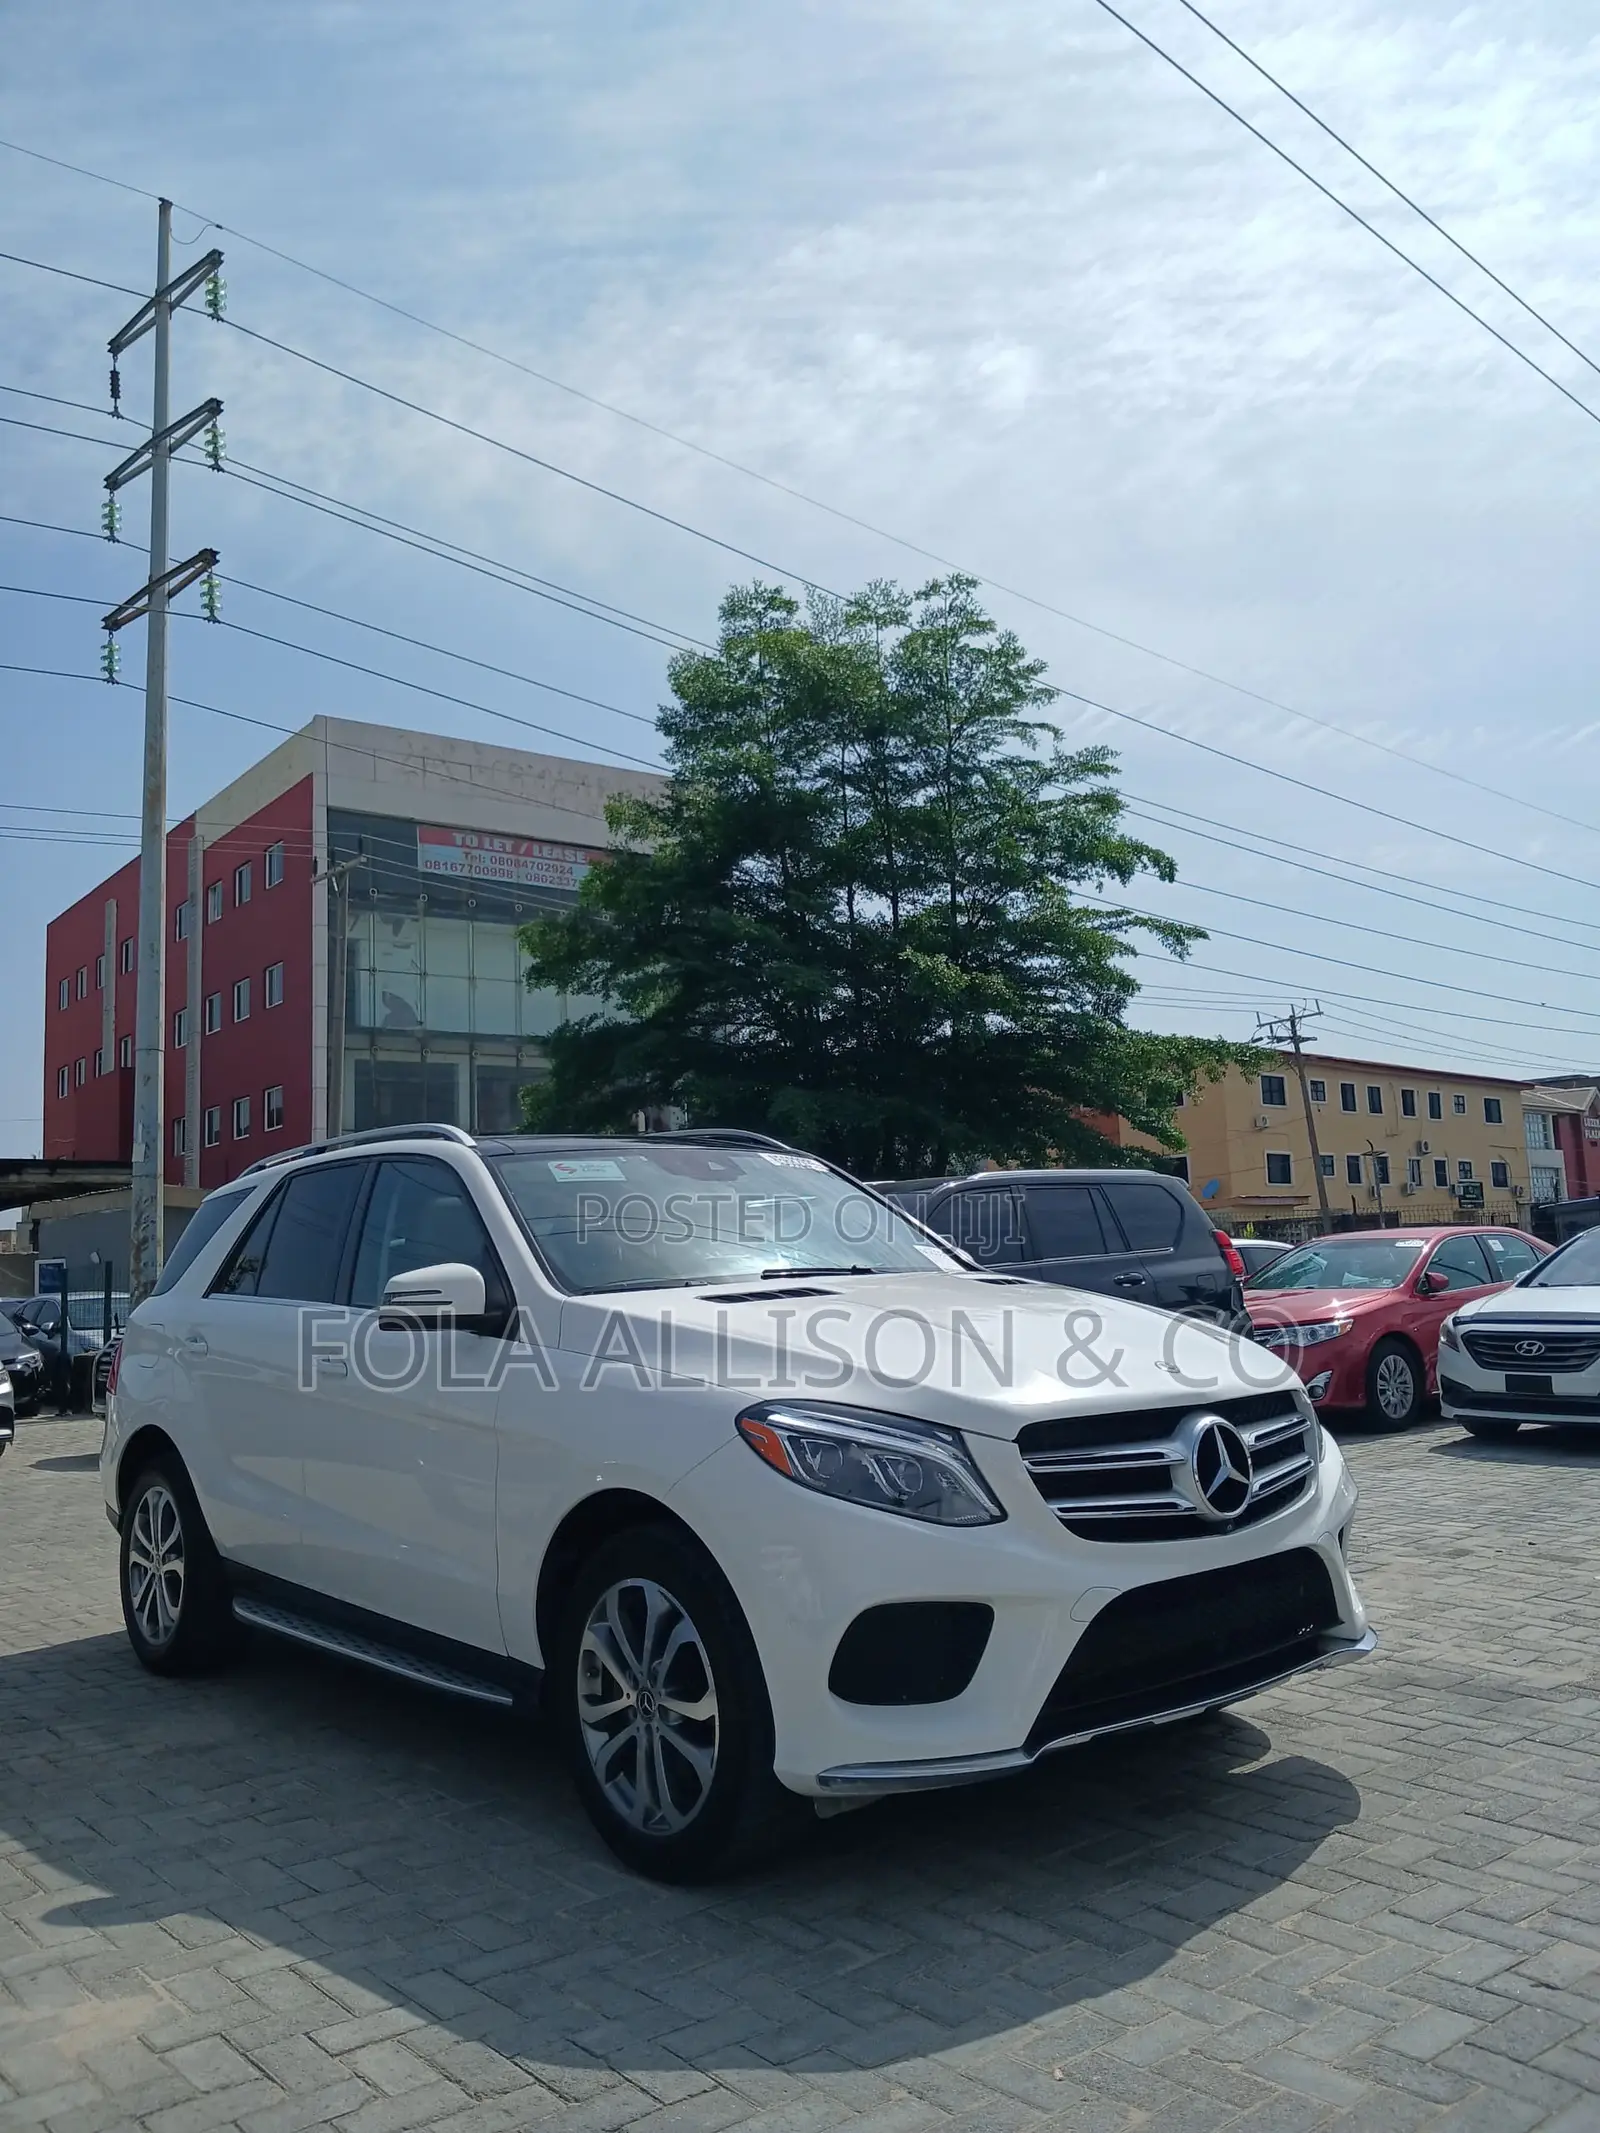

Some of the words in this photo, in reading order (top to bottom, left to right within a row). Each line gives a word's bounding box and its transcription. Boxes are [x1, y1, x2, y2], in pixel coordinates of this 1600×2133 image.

[452, 832, 479, 848] TO
[484, 836, 515, 853] LET
[533, 843, 588, 864] LEASE
[463, 851, 487, 864] Tel:
